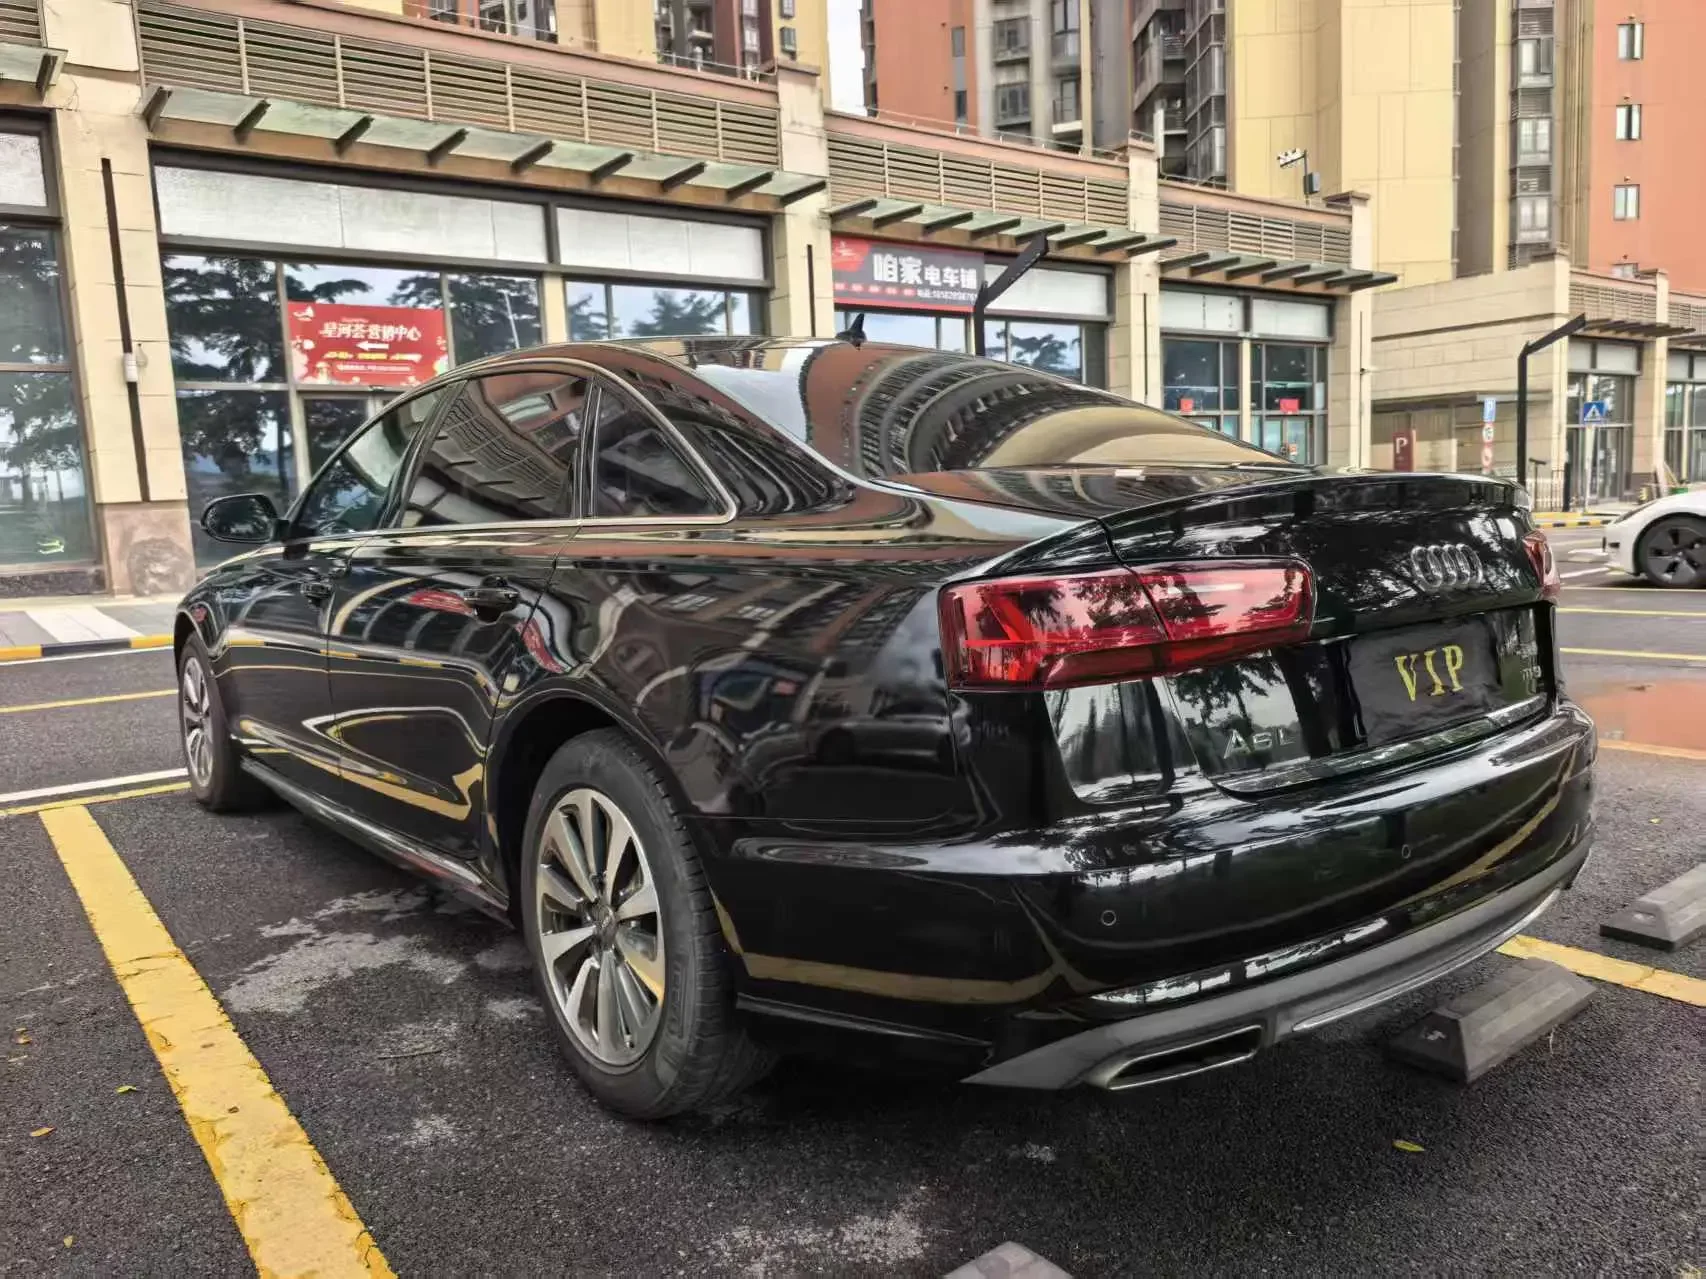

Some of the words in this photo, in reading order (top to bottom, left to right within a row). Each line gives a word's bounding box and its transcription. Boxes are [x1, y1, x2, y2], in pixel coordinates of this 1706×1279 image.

[873, 253, 977, 288] 咱家电车铺
[1396, 437, 1408, 454] P
[1394, 645, 1464, 701] VIP
